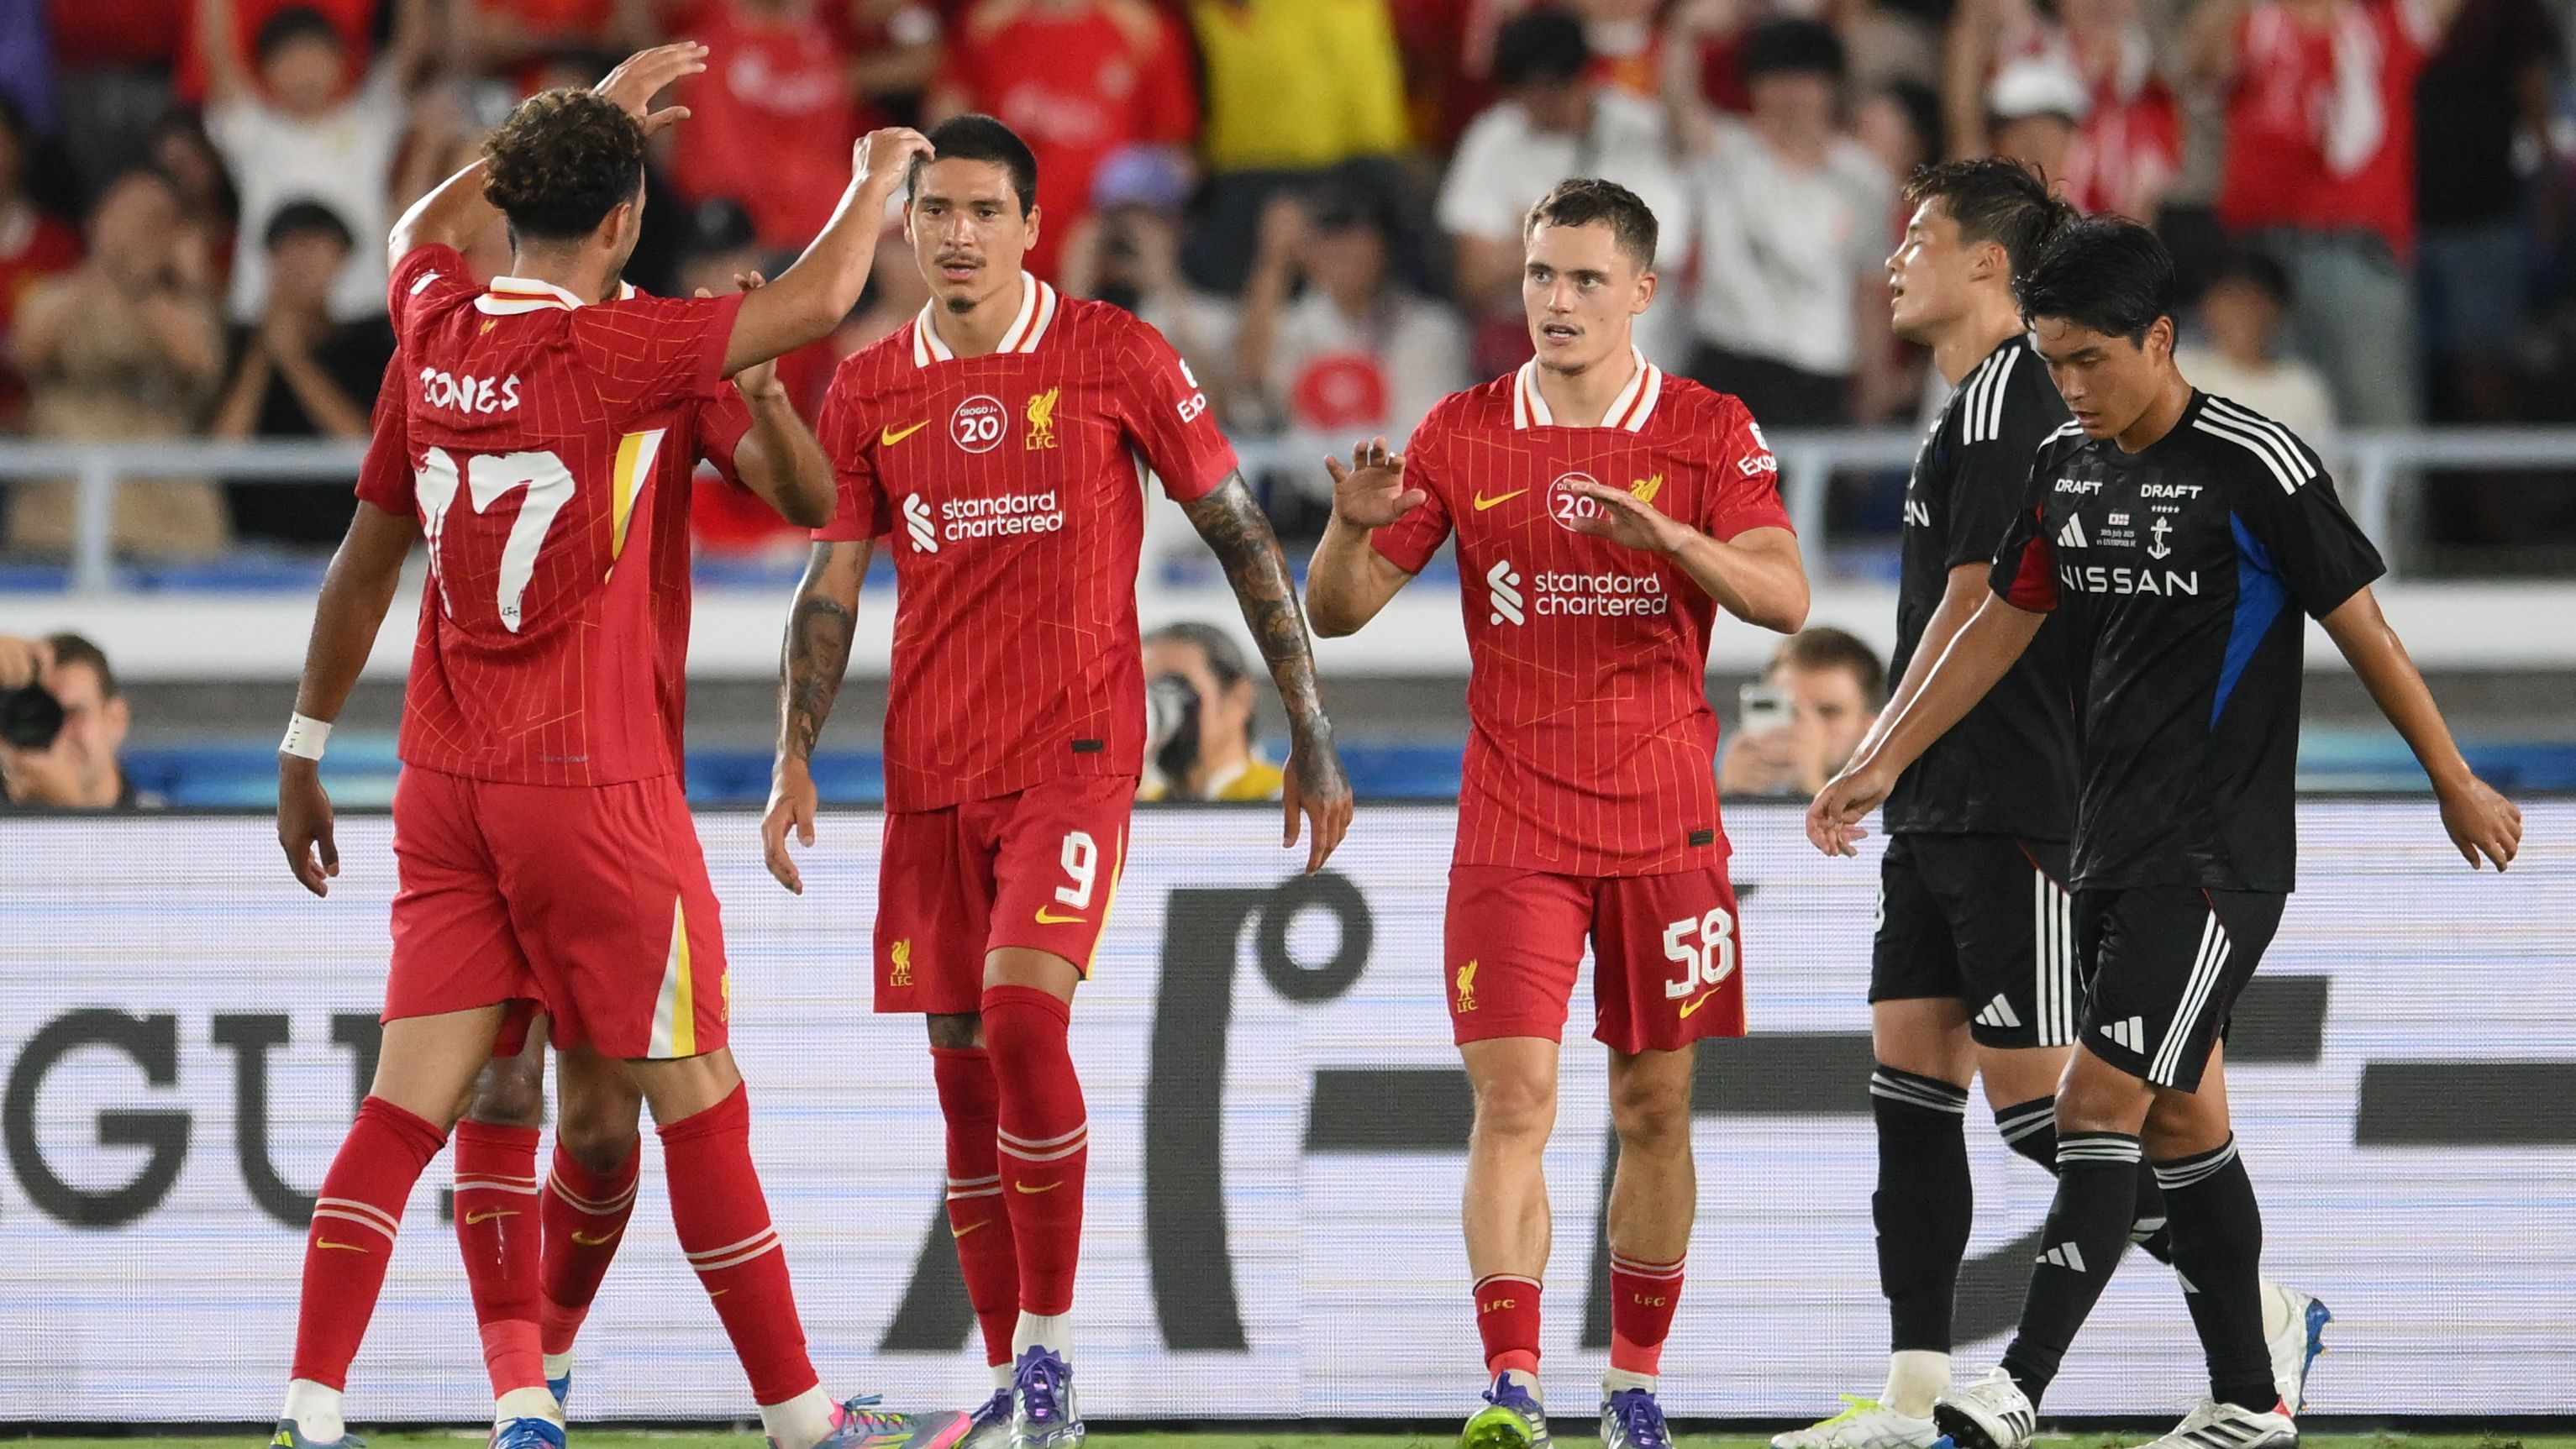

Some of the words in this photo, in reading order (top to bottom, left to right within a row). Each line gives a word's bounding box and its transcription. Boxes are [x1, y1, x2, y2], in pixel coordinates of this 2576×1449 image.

[420, 367, 520, 413] JONES
[960, 407, 988, 417] DIOGO
[959, 416, 999, 444] 20
[2055, 479, 2102, 496] DRAFT
[2140, 484, 2203, 500] DRAFT
[942, 490, 1055, 520] standard
[414, 446, 576, 633] 77
[945, 511, 1063, 541] chartered
[1535, 570, 1660, 593] standard
[2060, 564, 2198, 596] NISSAN
[1535, 593, 1668, 616] chartered
[1055, 831, 1097, 910] 9
[1663, 907, 1735, 999] 58
[1483, 1299, 1515, 1314] LFC
[1634, 1294, 1666, 1308] LFC
